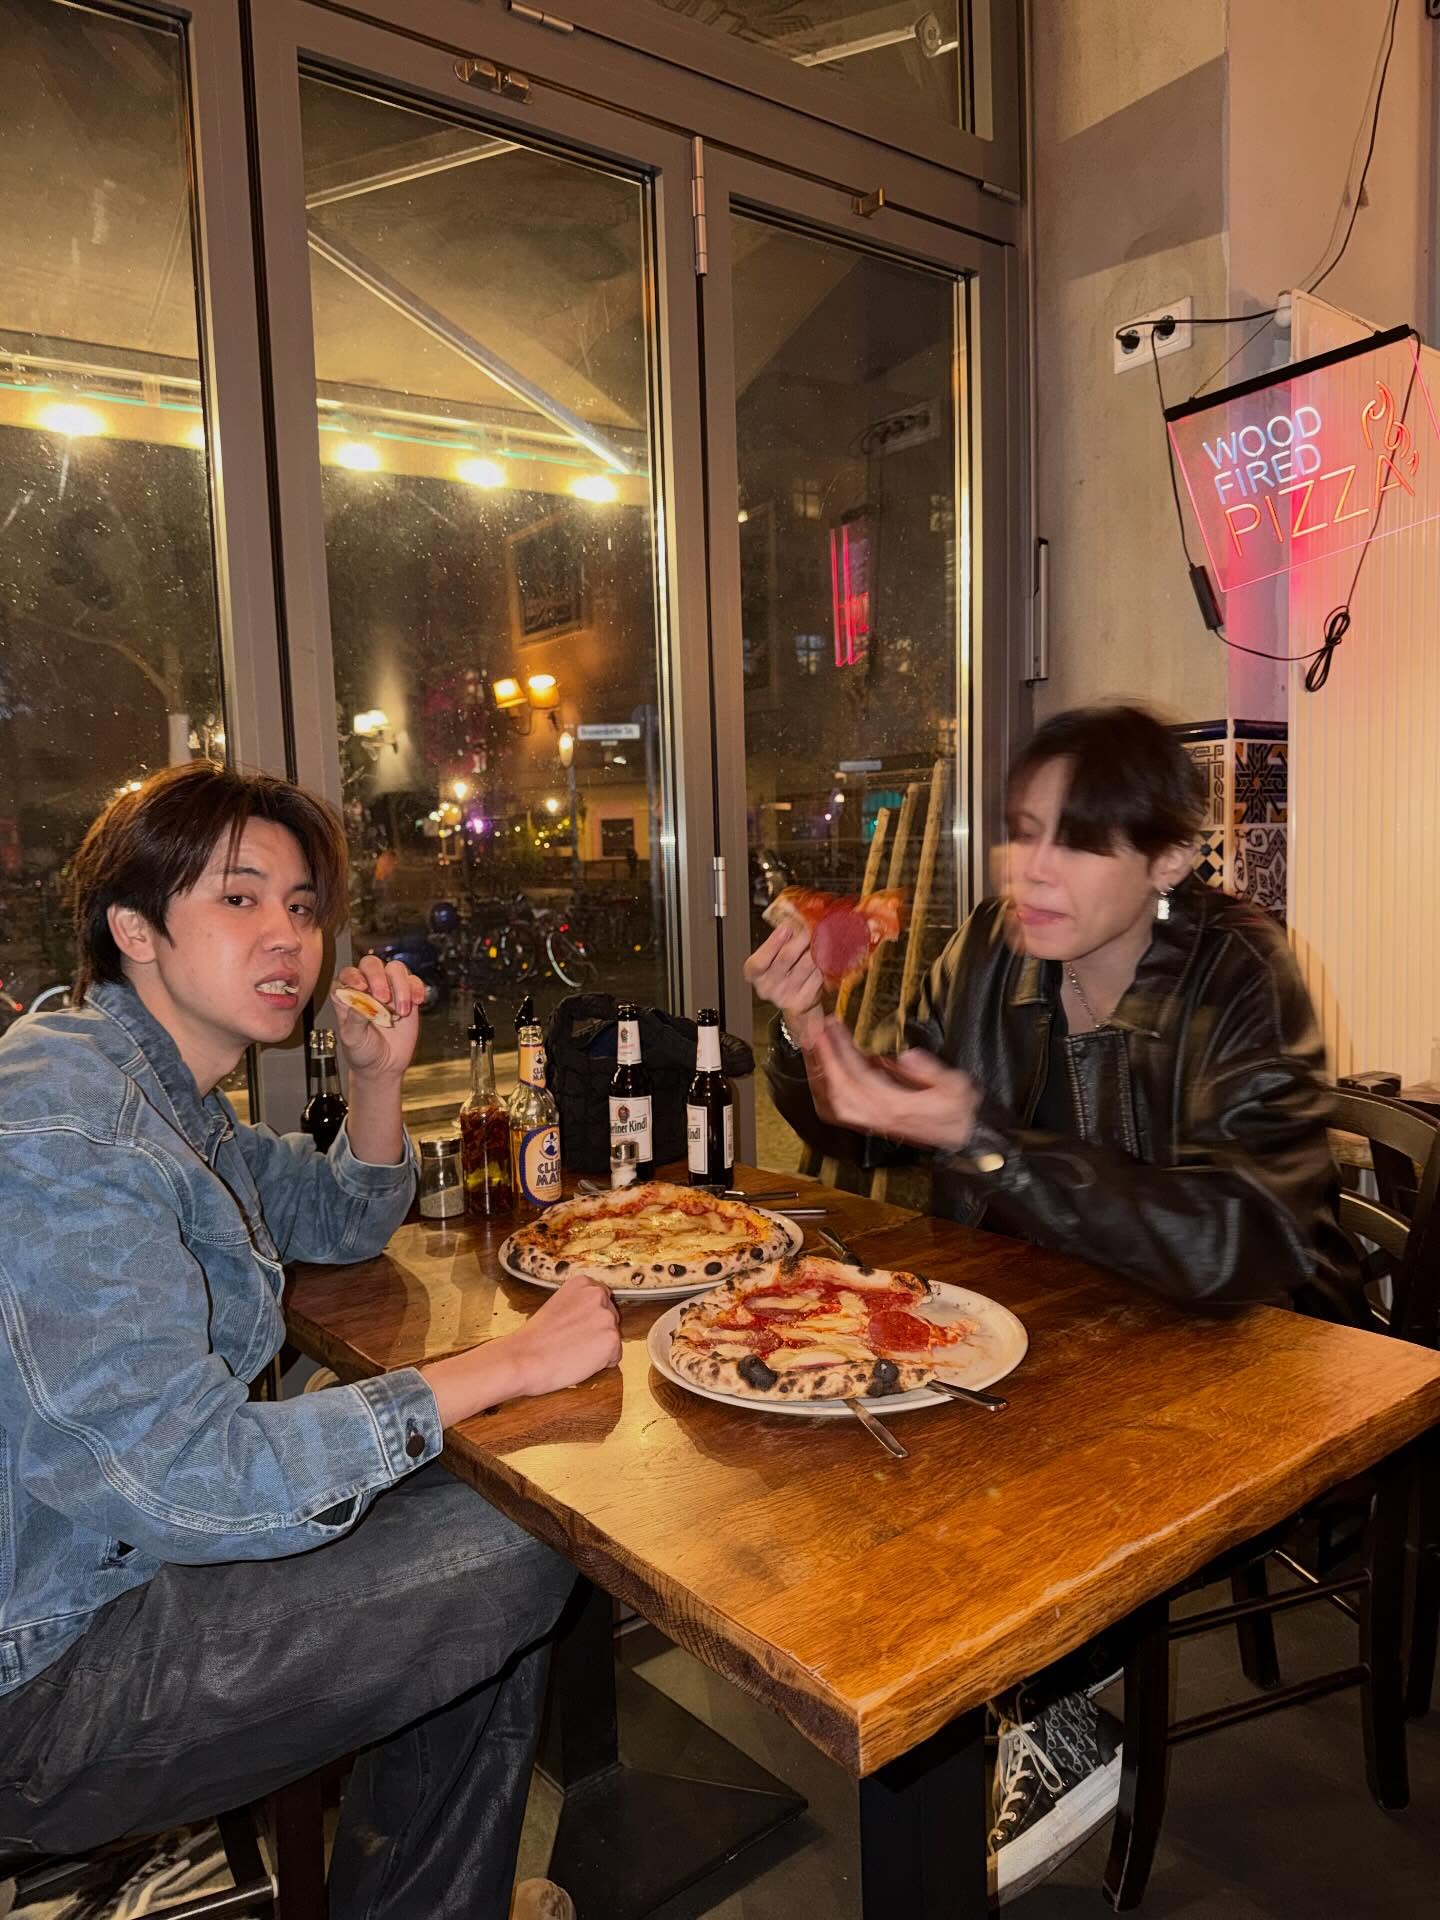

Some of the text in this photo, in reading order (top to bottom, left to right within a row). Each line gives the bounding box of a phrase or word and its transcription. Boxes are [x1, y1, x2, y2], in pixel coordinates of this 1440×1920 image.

[1202, 406, 1322, 470] WOOD
[1214, 444, 1322, 504] FIRED
[1224, 454, 1416, 557] PIZZA
[629, 1116, 648, 1133] Kindl
